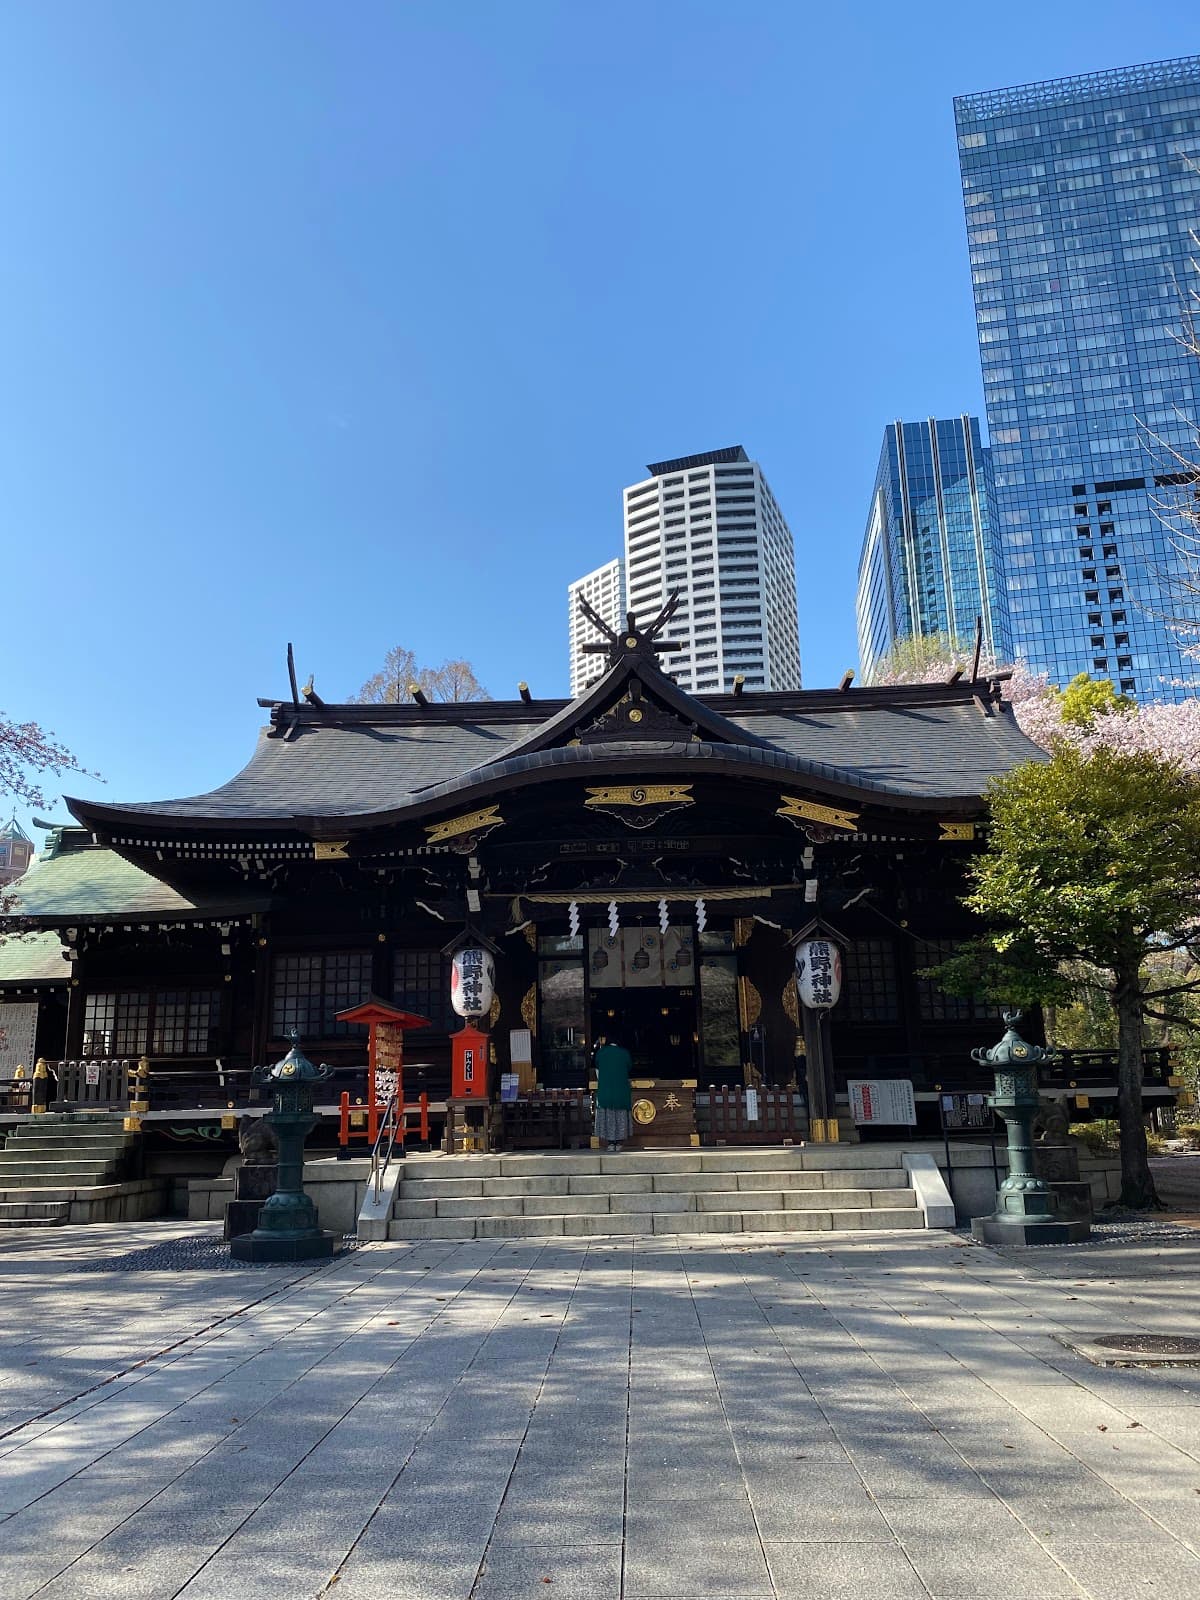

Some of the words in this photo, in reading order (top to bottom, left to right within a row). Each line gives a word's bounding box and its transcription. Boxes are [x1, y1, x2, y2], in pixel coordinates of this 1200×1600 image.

[463, 951, 483, 1011] 熊野神社
[810, 942, 832, 1003] 熊野神社
[663, 1092, 681, 1111] 奉
